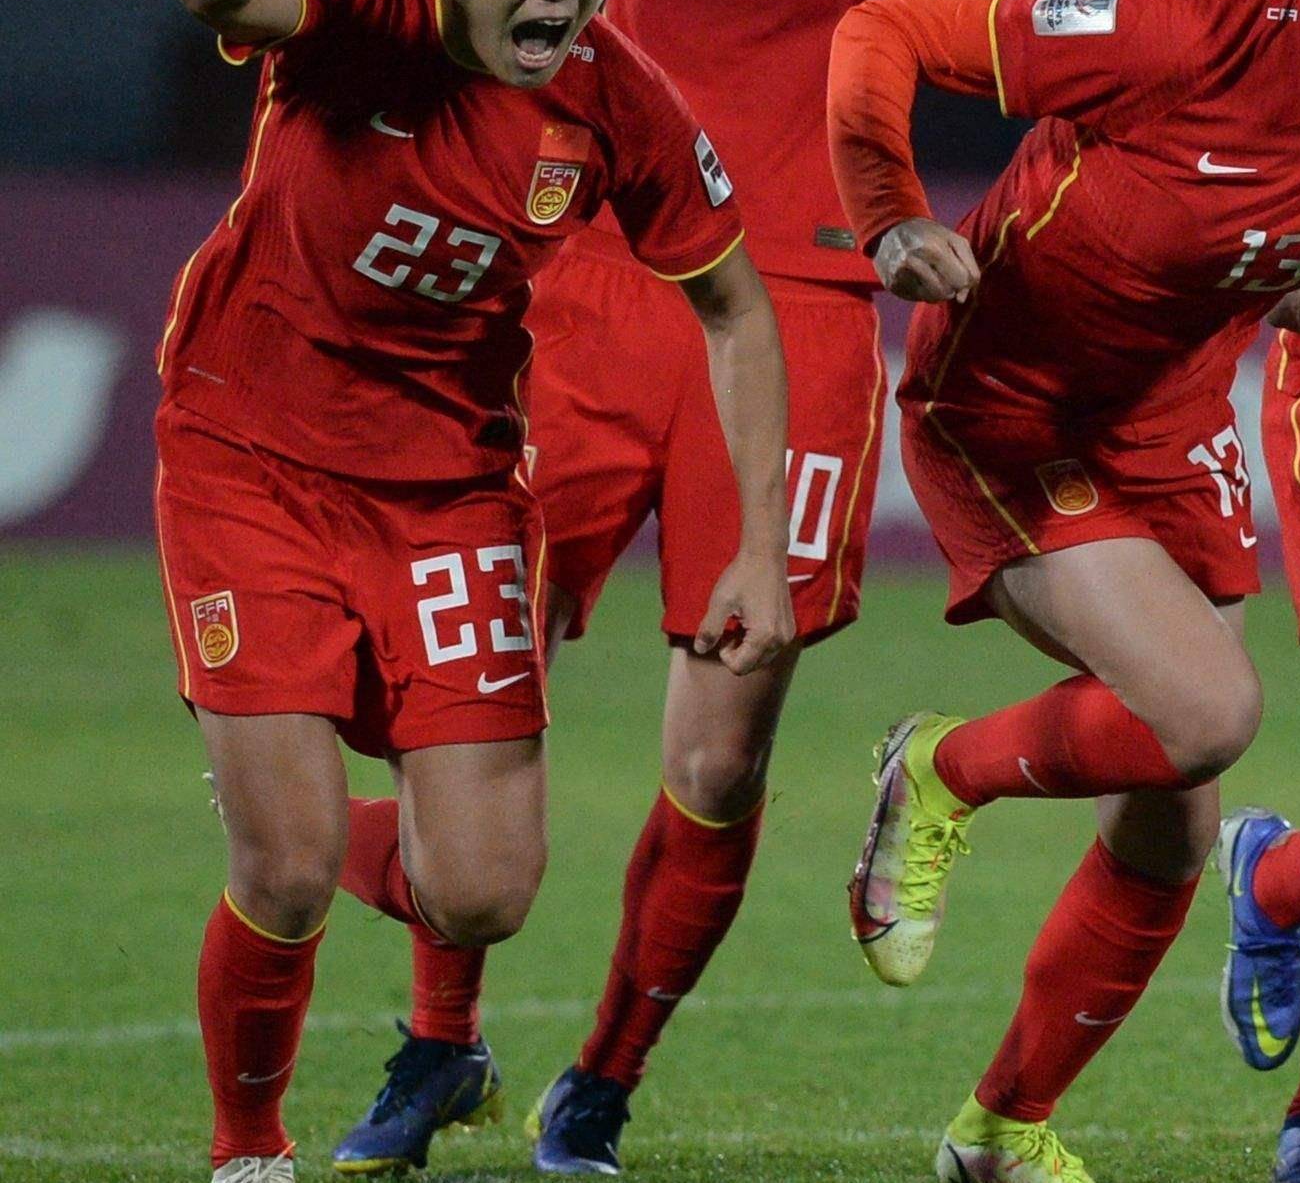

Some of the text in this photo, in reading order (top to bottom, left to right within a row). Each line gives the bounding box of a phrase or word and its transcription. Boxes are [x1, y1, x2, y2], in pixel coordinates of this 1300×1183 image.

[540, 167, 576, 178] CFA
[352, 203, 501, 303] 23
[785, 449, 843, 560] 0
[196, 599, 228, 619] CFA
[411, 544, 534, 666] 23
